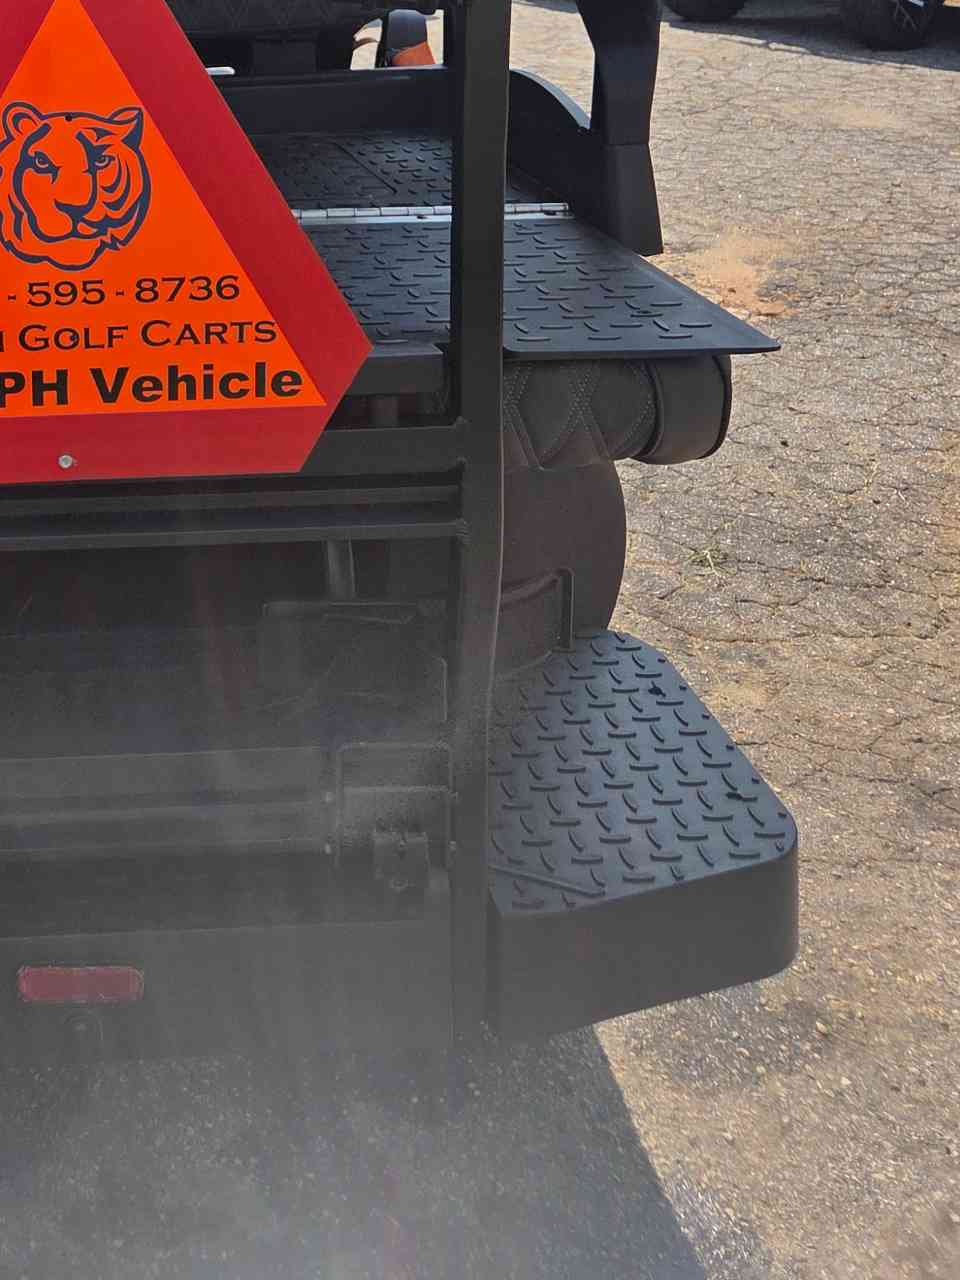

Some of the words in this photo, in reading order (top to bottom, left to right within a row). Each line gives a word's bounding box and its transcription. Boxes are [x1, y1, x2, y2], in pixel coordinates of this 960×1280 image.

[18, 324, 129, 352] GOLF
[140, 319, 278, 347] CARTS
[89, 361, 304, 404] Vehicle
